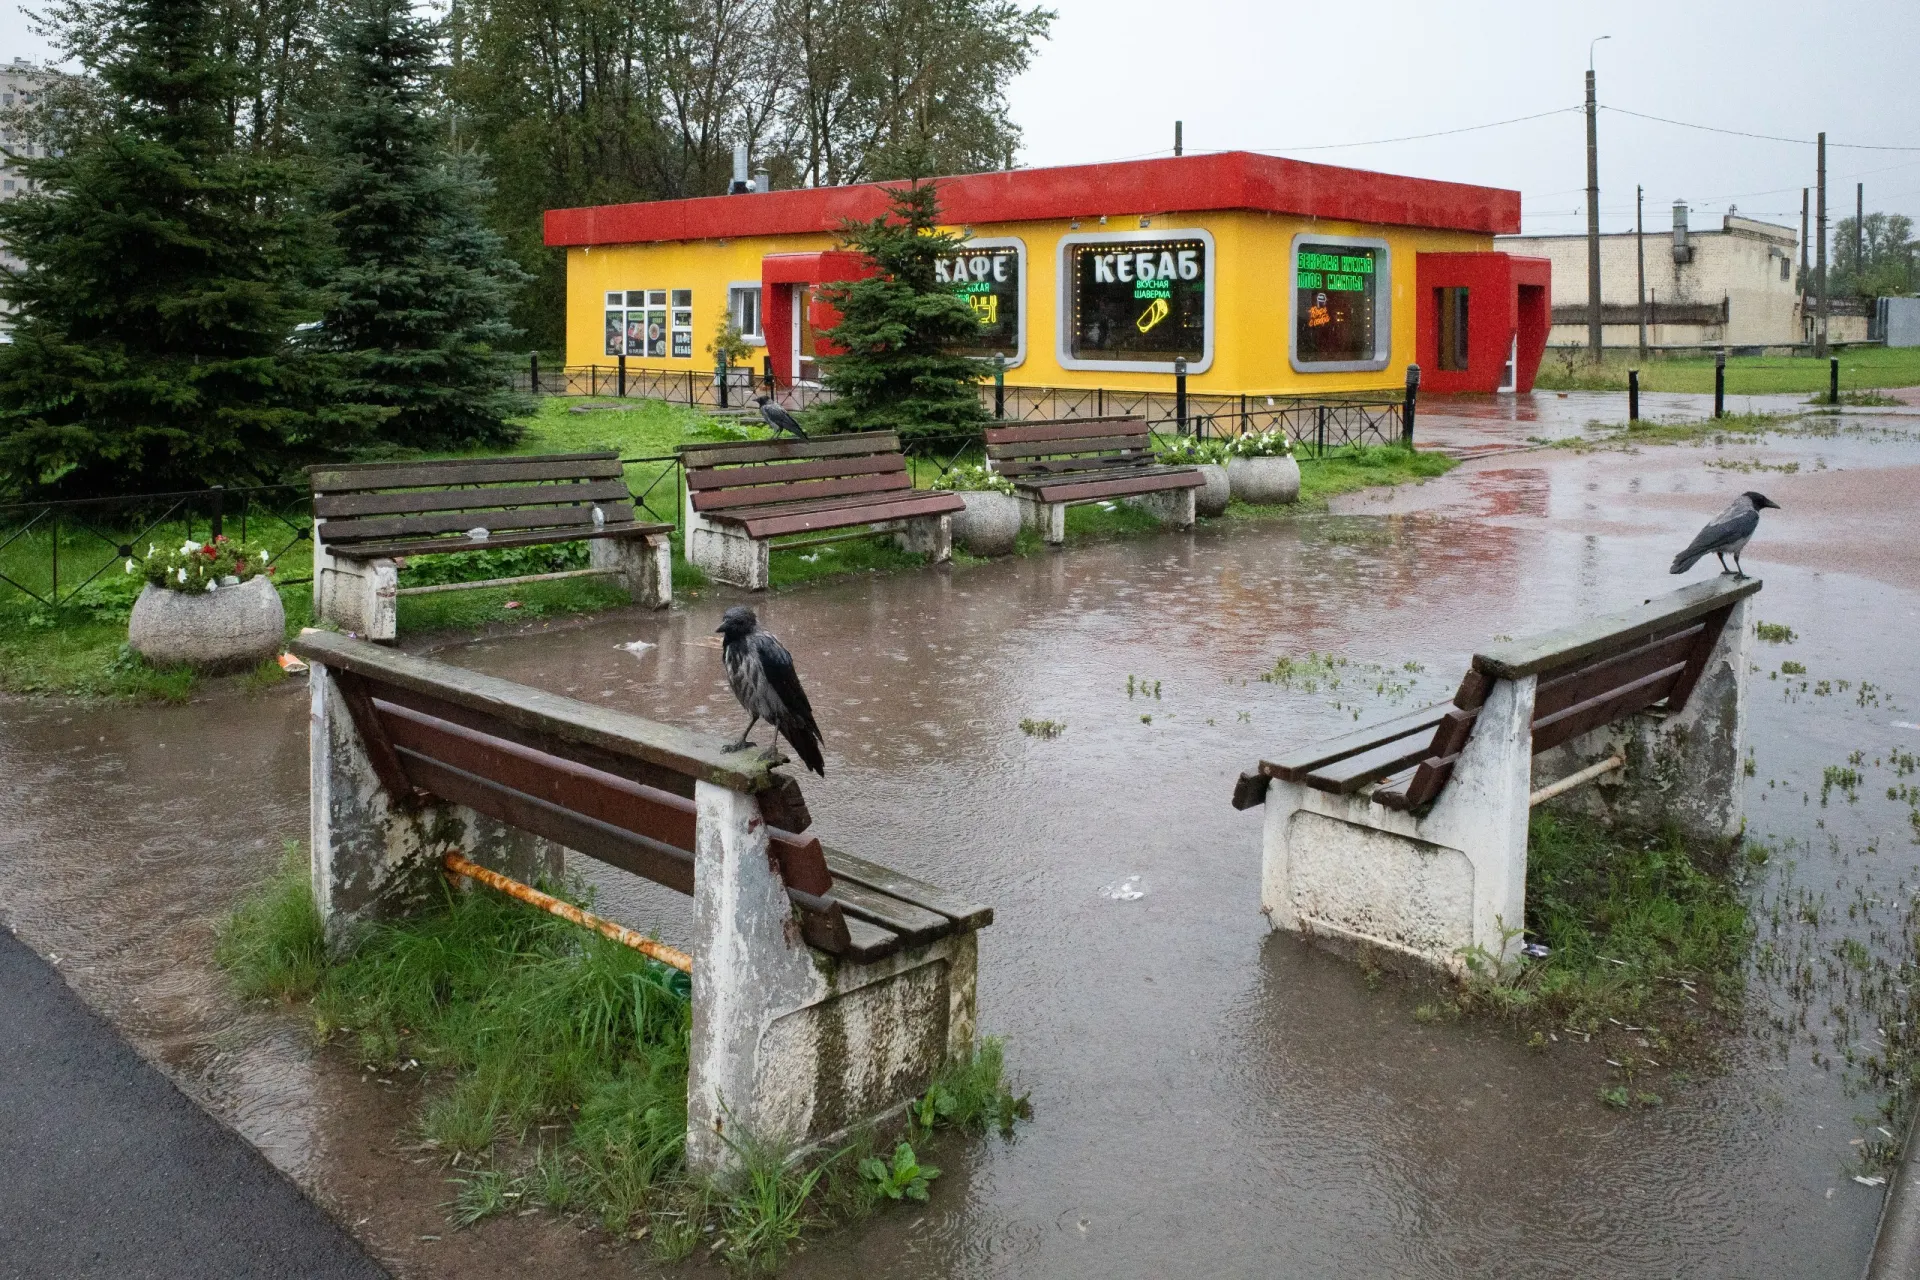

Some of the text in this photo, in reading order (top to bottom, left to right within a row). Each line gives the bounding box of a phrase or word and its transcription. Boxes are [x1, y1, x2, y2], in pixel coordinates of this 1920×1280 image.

[934, 256, 1007, 283] КАФЕ
[1094, 251, 1198, 282] КЕБАБ
[1136, 280, 1169, 288] ВКУСНАЯ
[1327, 274, 1363, 291] МАНТЫ
[1135, 290, 1170, 298] ШАВЕРМА
